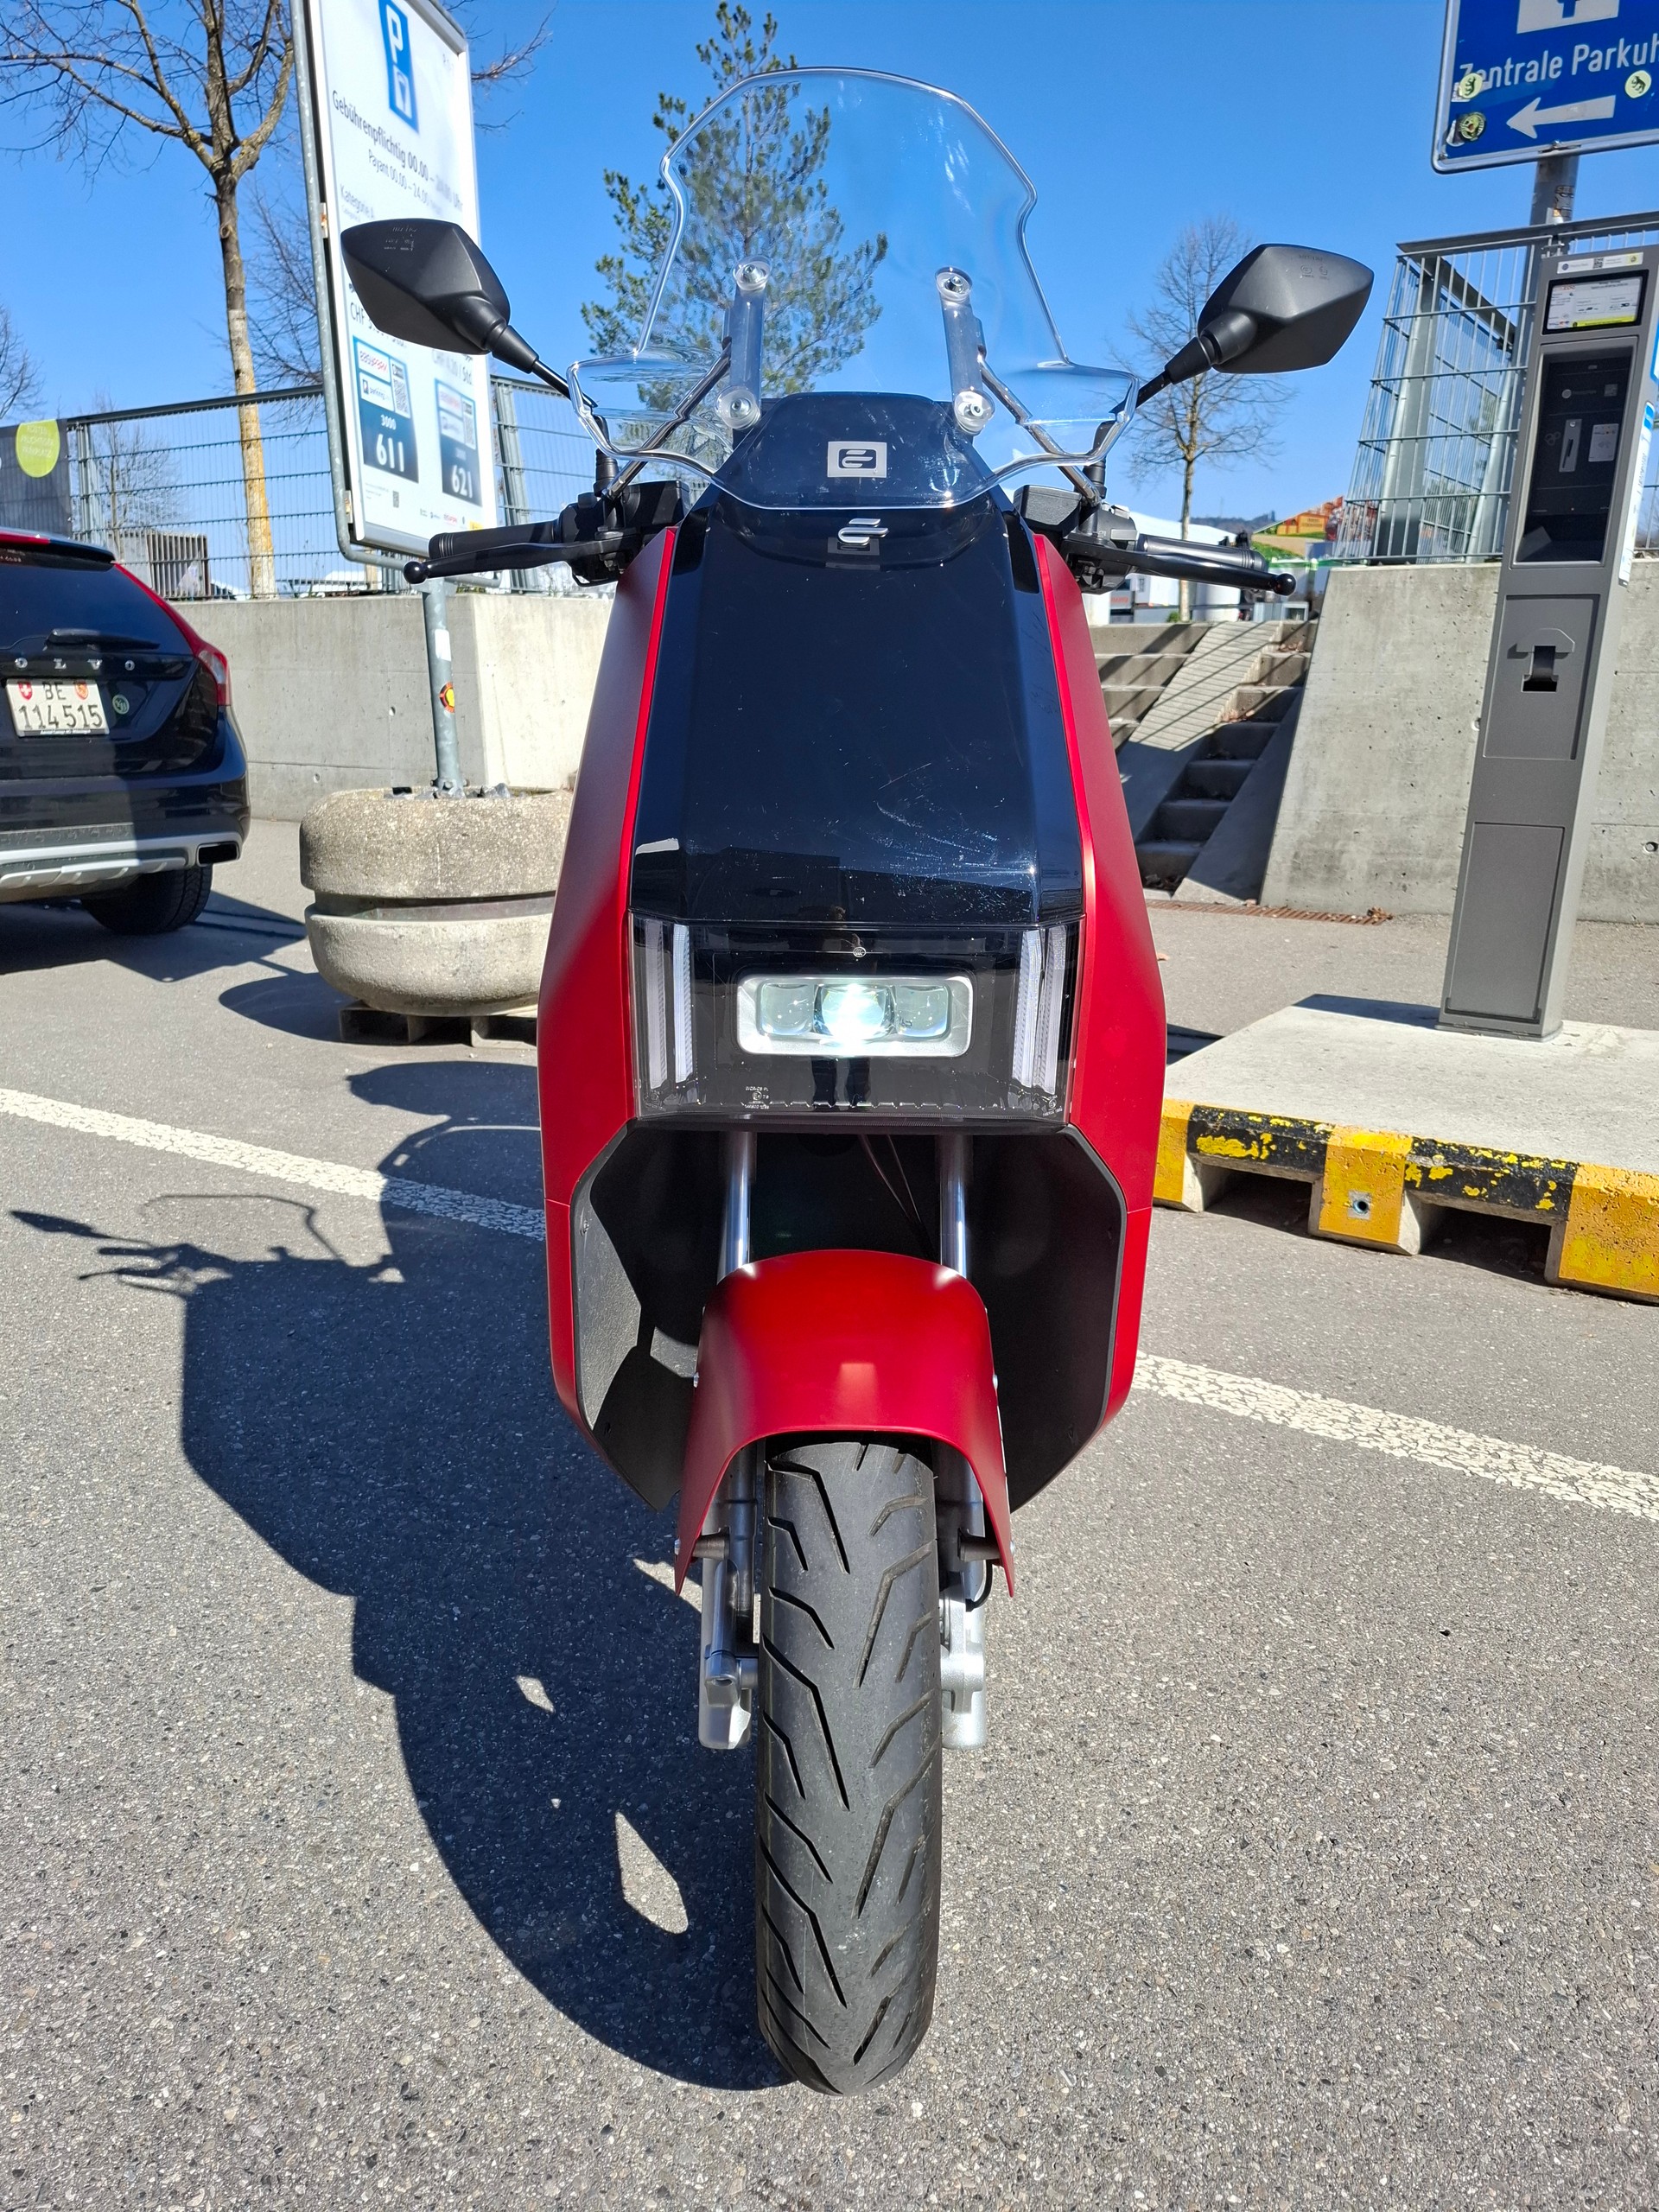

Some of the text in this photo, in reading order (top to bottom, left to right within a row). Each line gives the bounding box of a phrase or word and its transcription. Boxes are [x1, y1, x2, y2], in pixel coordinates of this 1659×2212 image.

[332, 90, 406, 168] Gebührenpflichtig
[408, 151, 429, 181] 00.00
[368, 149, 389, 177] Payant
[375, 433, 405, 473] 611
[451, 464, 473, 499] 621
[43, 682, 67, 701] BE
